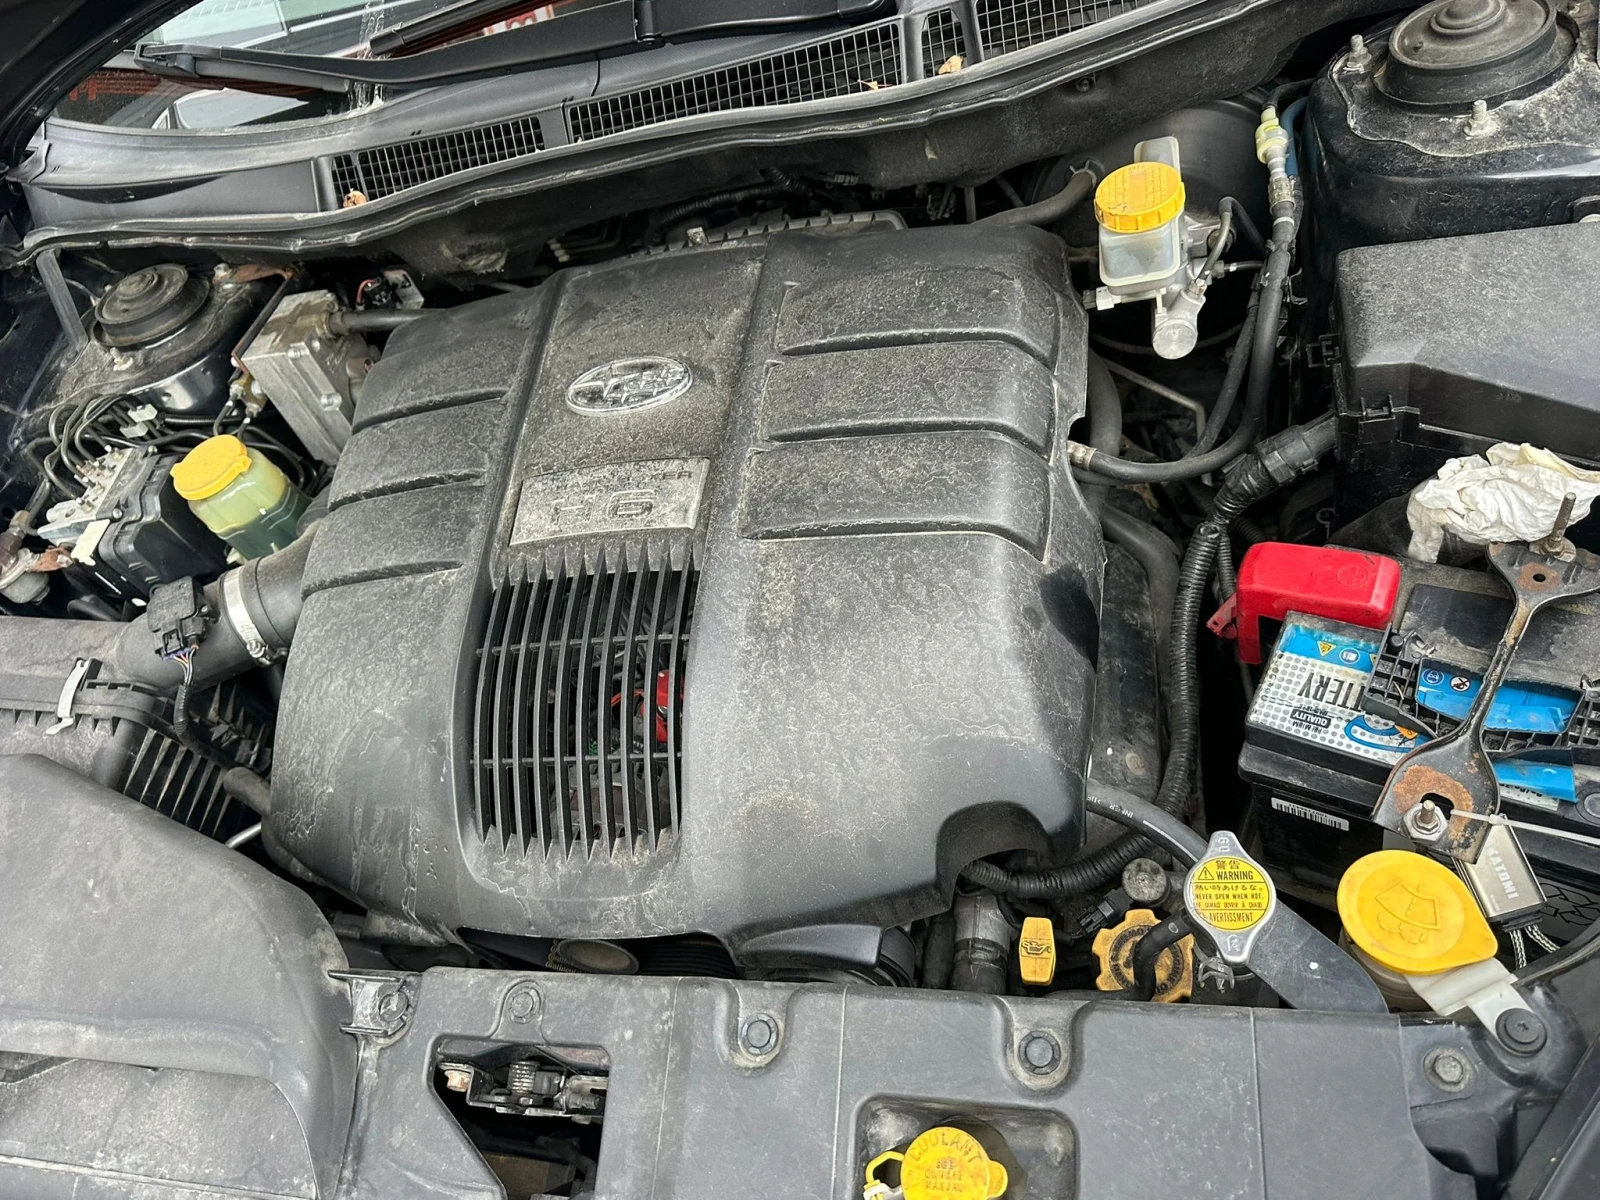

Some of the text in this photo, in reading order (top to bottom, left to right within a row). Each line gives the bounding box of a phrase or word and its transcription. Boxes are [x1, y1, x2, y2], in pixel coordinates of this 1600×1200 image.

[1297, 672, 1366, 713] TTERY
[1293, 711, 1328, 727] QUALITY
[1216, 871, 1254, 881] WARNING
[909, 1132, 984, 1164] COOLANT
